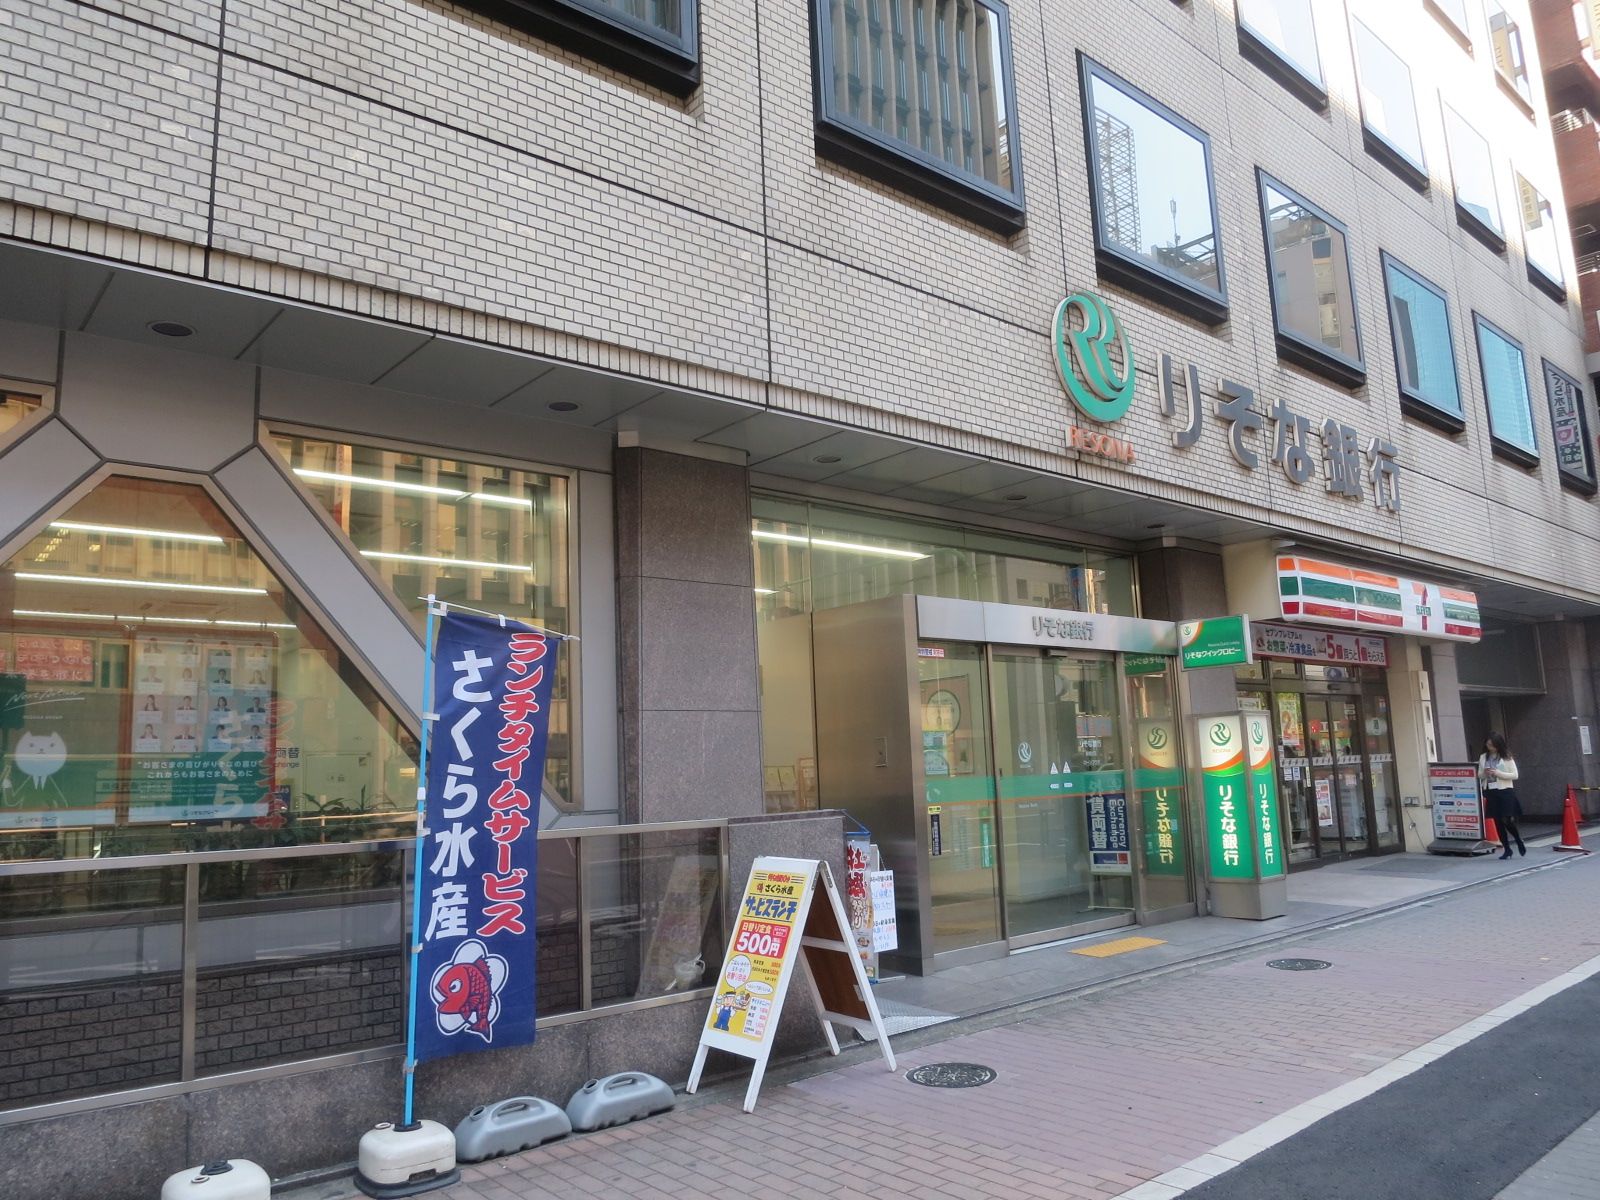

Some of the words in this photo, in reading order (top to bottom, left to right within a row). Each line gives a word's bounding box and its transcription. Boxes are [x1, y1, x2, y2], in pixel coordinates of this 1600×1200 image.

[1065, 425, 1136, 465] RESONA
[1157, 351, 1400, 512] りそな銀行
[1032, 615, 1095, 640] りそな銀行
[1184, 648, 1241, 660] りそなクイックロビー
[424, 649, 493, 943] さくら水産
[476, 632, 547, 936] ランチタイムサービス
[1109, 799, 1120, 849] Exchange
[1117, 798, 1127, 848] Currency
[1218, 784, 1239, 866] りそな銀行
[1258, 783, 1274, 865] りそな銀行
[745, 896, 798, 921] サービスランチ
[765, 883, 795, 896] さくら水産
[736, 932, 781, 957] 500円
[742, 922, 772, 935] 日替り定食
